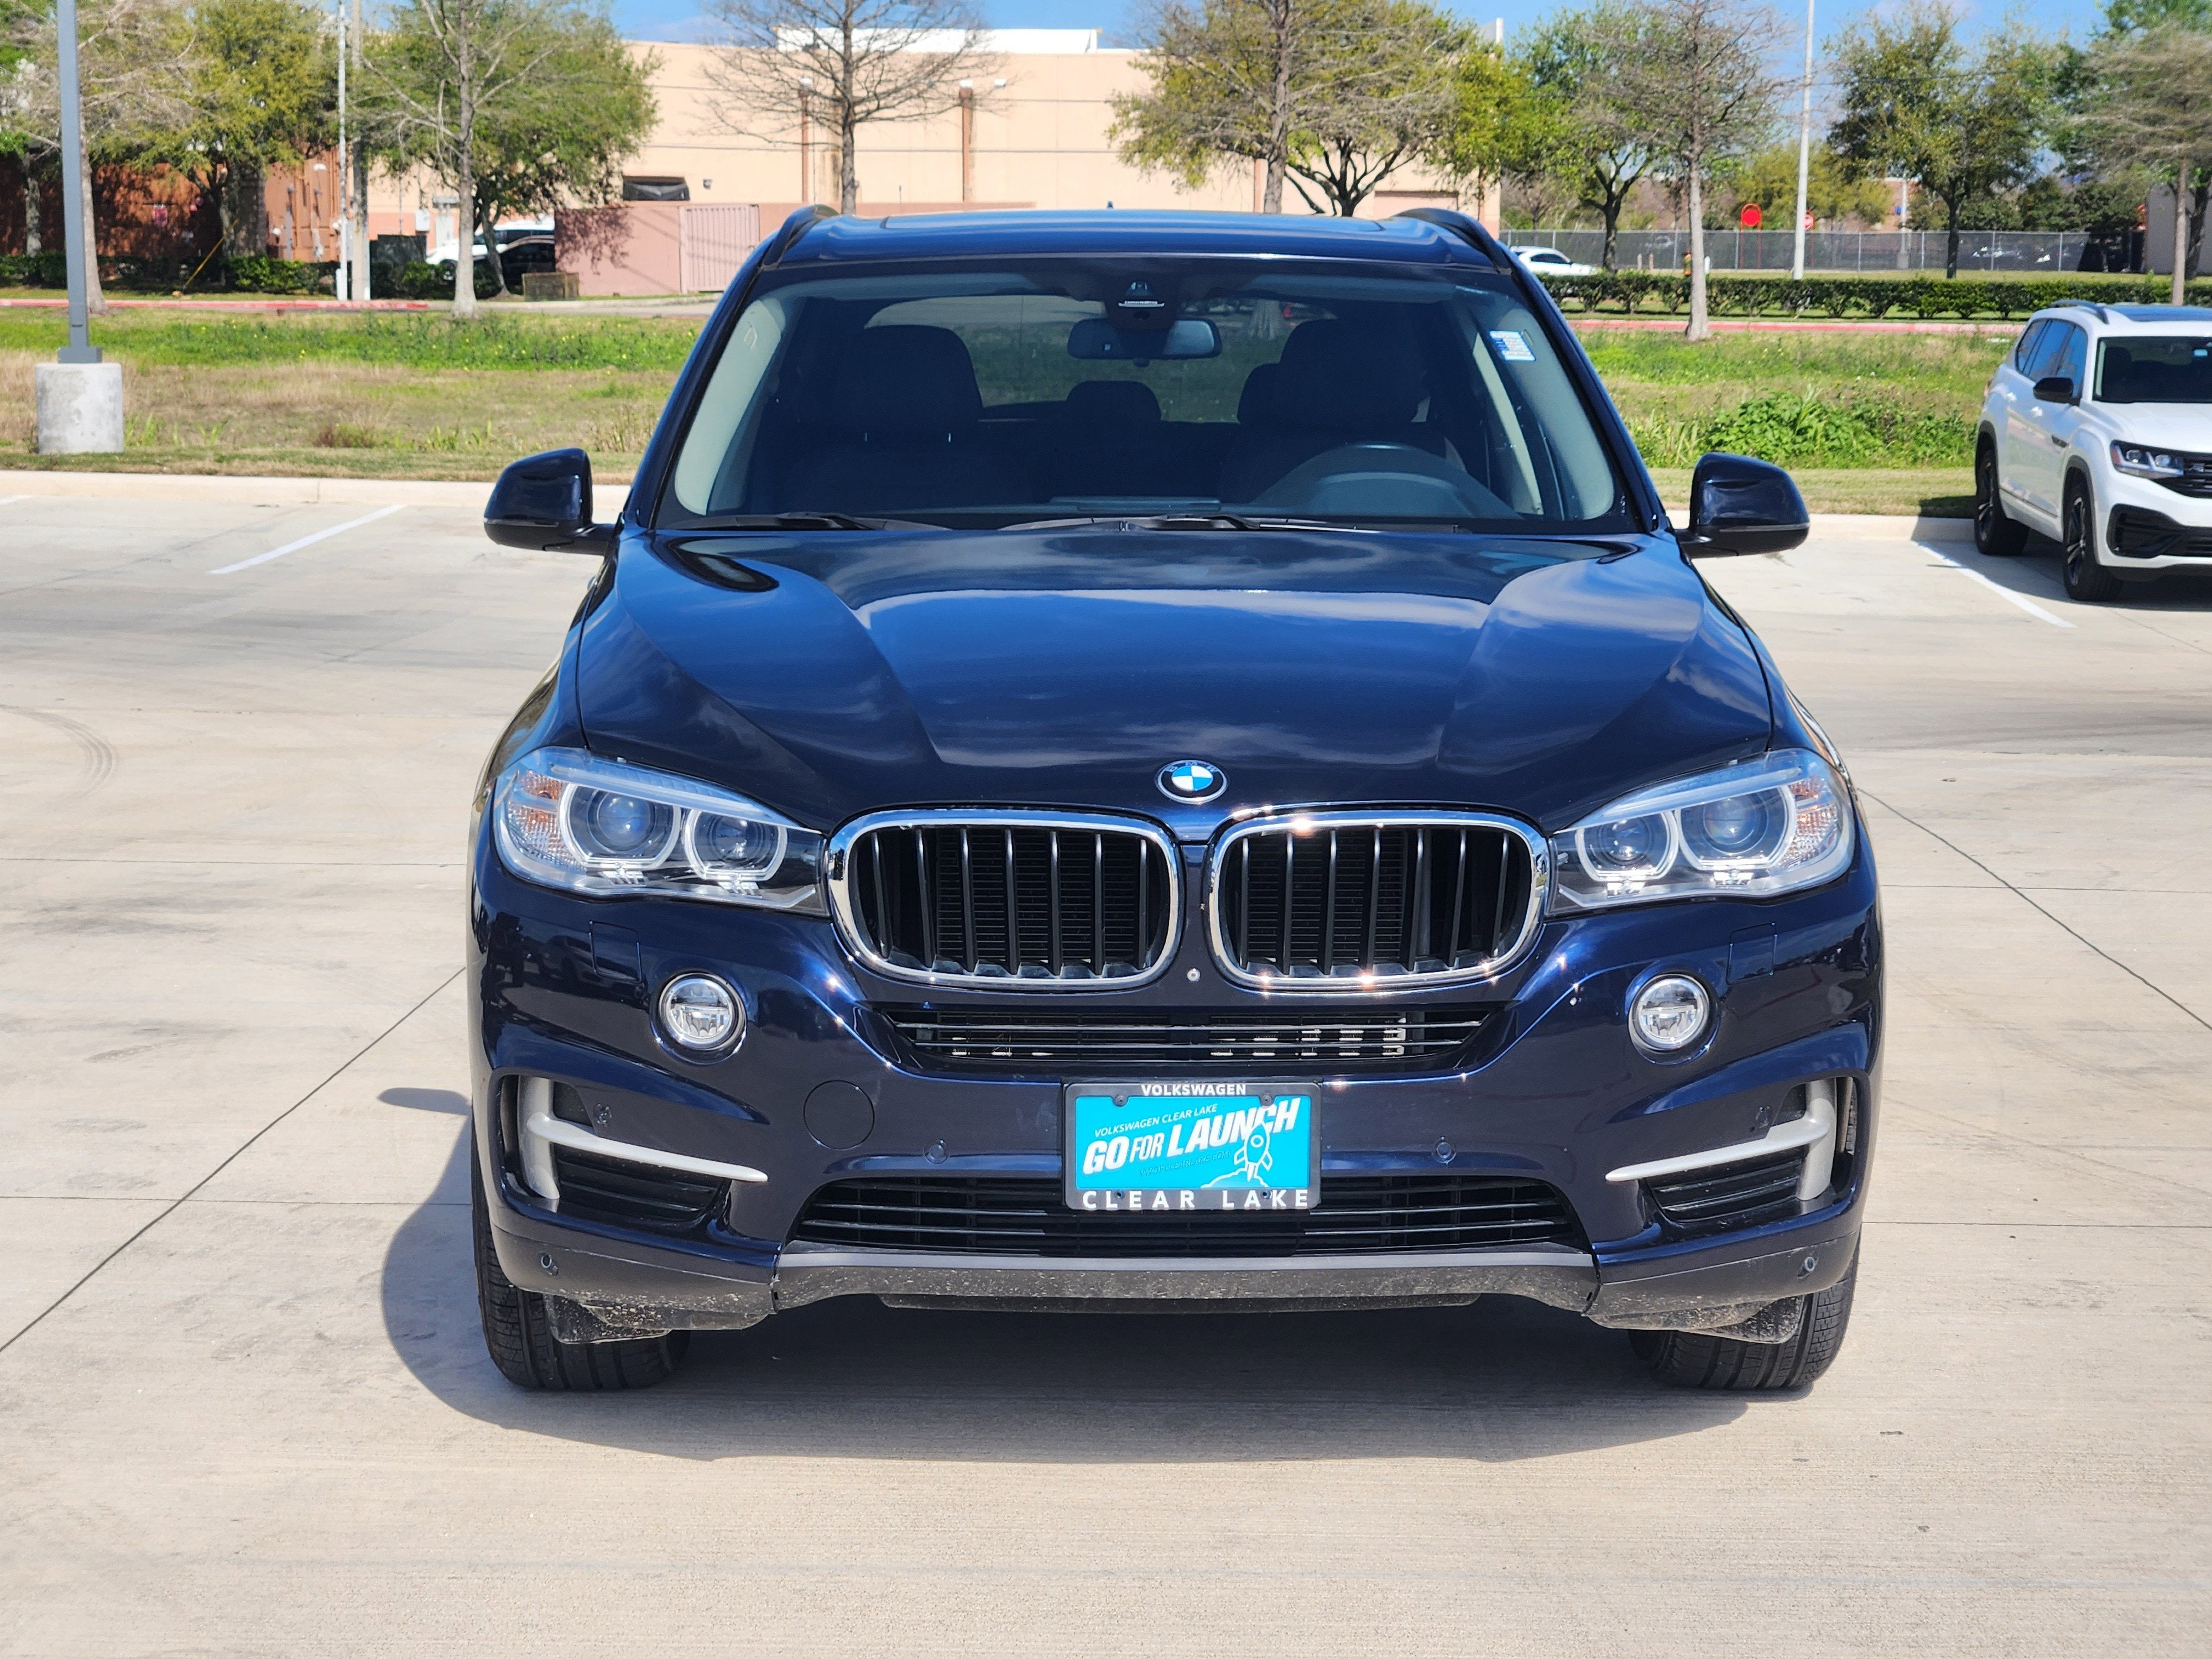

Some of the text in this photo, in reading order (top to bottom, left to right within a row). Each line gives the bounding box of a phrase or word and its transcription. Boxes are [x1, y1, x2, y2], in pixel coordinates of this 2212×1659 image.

[1165, 760, 1219, 773] BMW
[1141, 1084, 1246, 1096] VOLKSWAGEN
[1094, 1104, 1218, 1138] VOLKSWAGEN CLEAR LAKE
[1083, 1097, 1301, 1175] GO FOR LAUNCH
[1082, 1190, 1308, 1209] CLEAR LAKE
